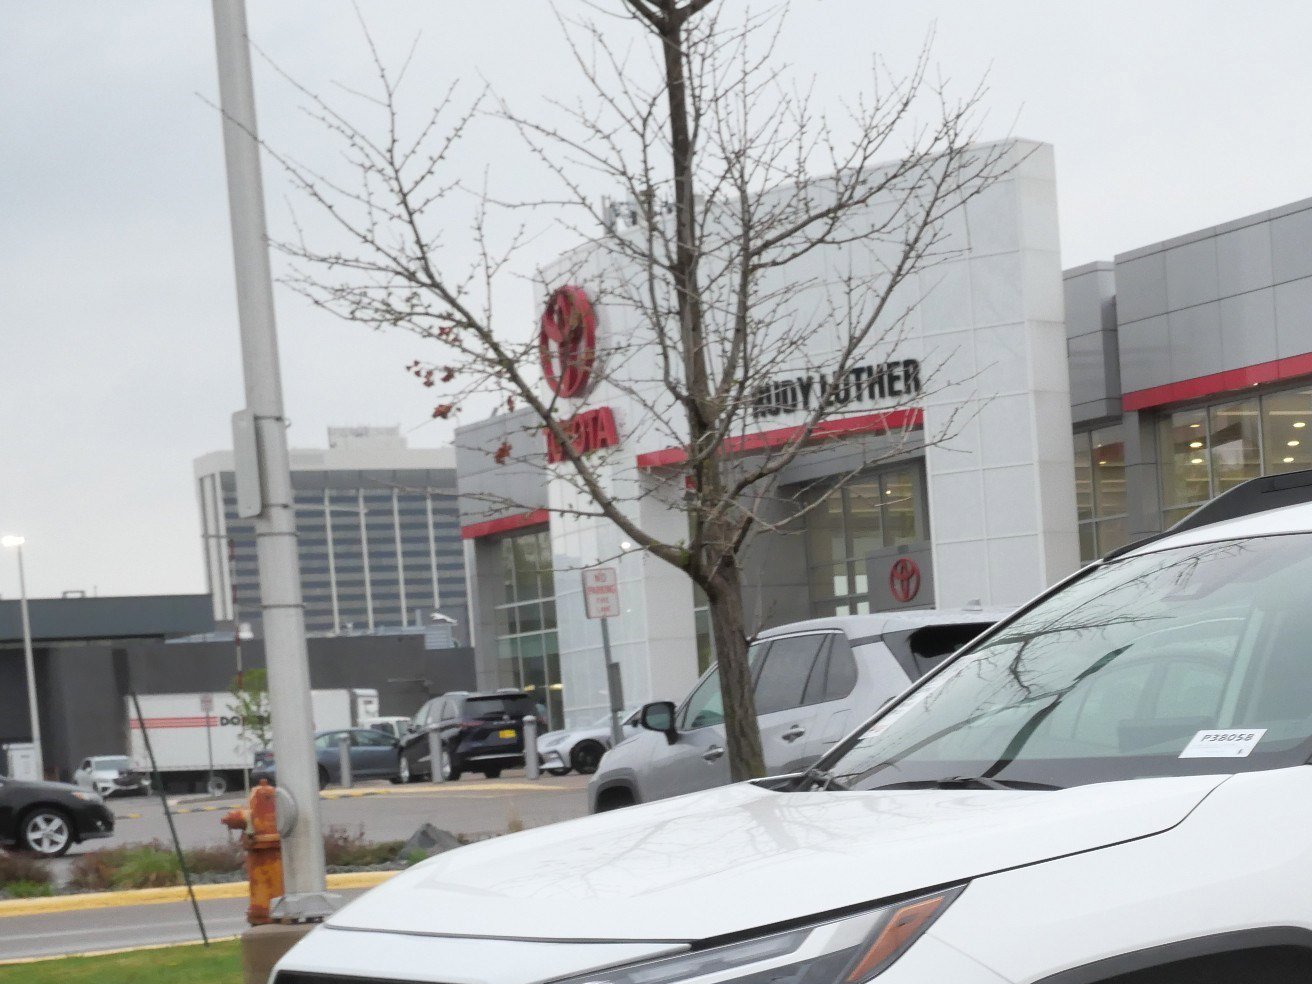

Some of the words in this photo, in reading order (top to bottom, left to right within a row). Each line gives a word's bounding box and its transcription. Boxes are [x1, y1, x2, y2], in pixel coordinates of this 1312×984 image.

[753, 376, 813, 418] RUDY
[820, 359, 920, 406] LUTHER
[543, 406, 619, 464] TOTA
[1200, 732, 1255, 743] P38058
